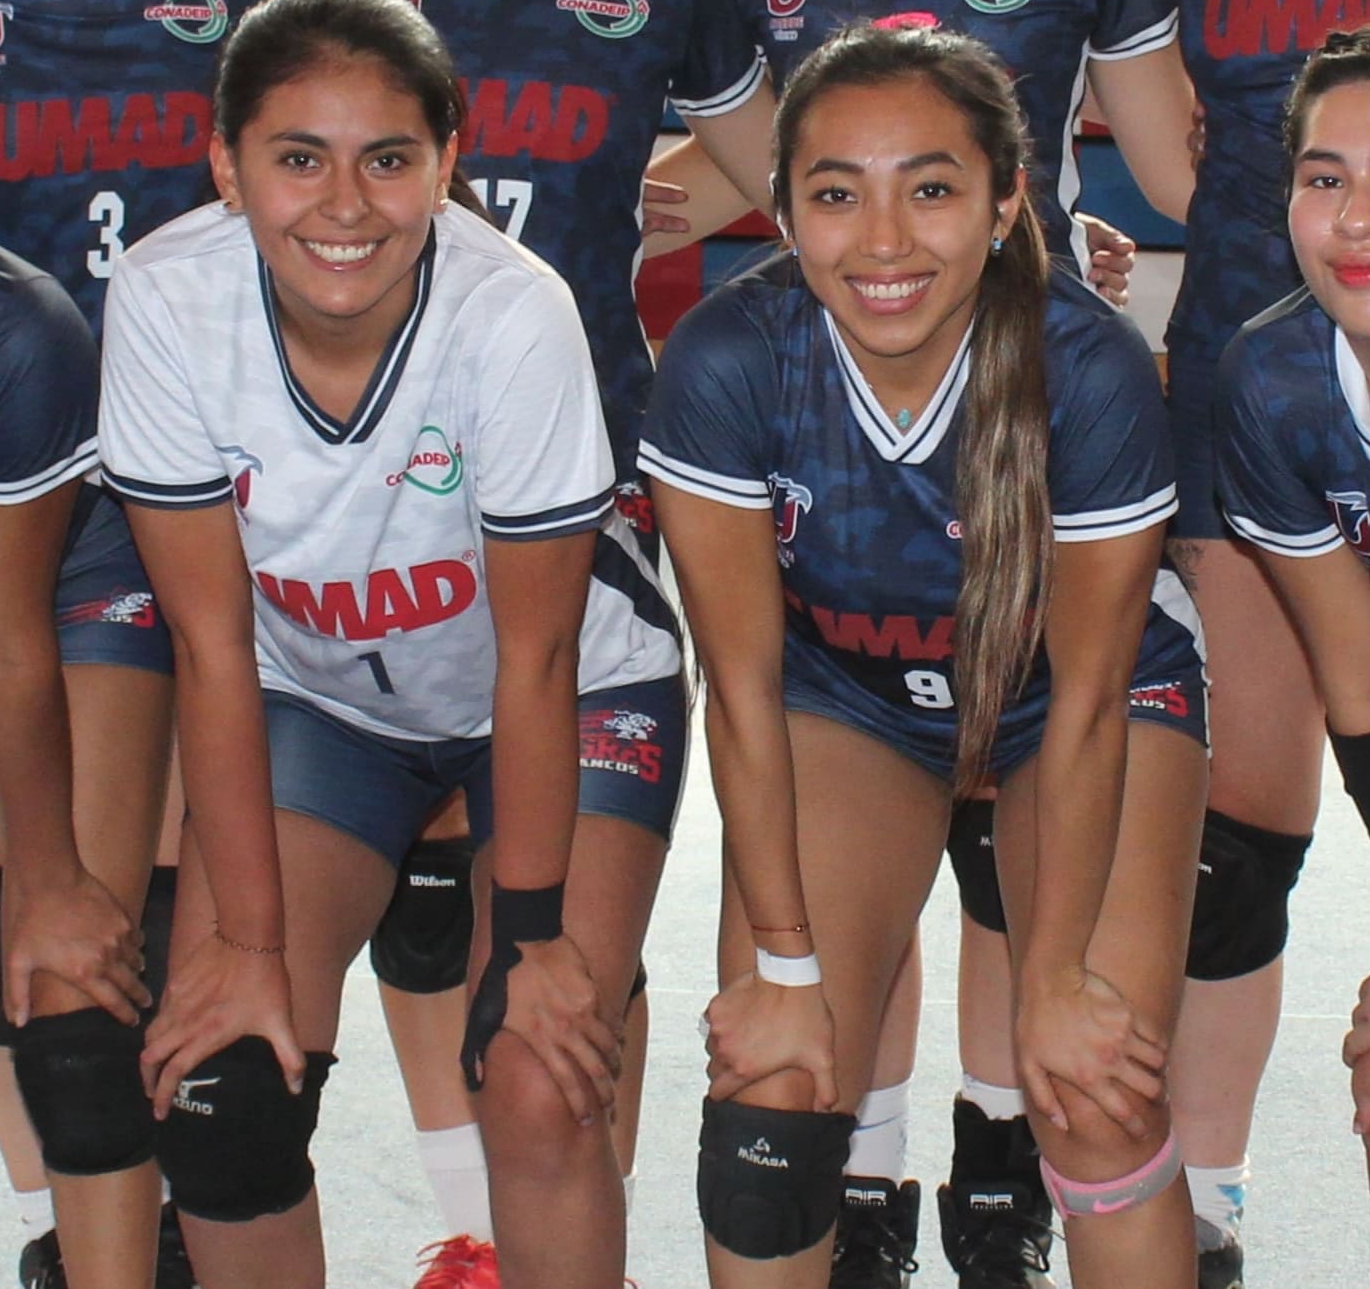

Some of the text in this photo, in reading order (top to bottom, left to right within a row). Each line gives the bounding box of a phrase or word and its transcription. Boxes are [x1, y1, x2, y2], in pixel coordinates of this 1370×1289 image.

[87, 191, 125, 279] 3
[357, 651, 394, 695] 1
[903, 670, 954, 708] 9
[409, 874, 456, 887] Wilson
